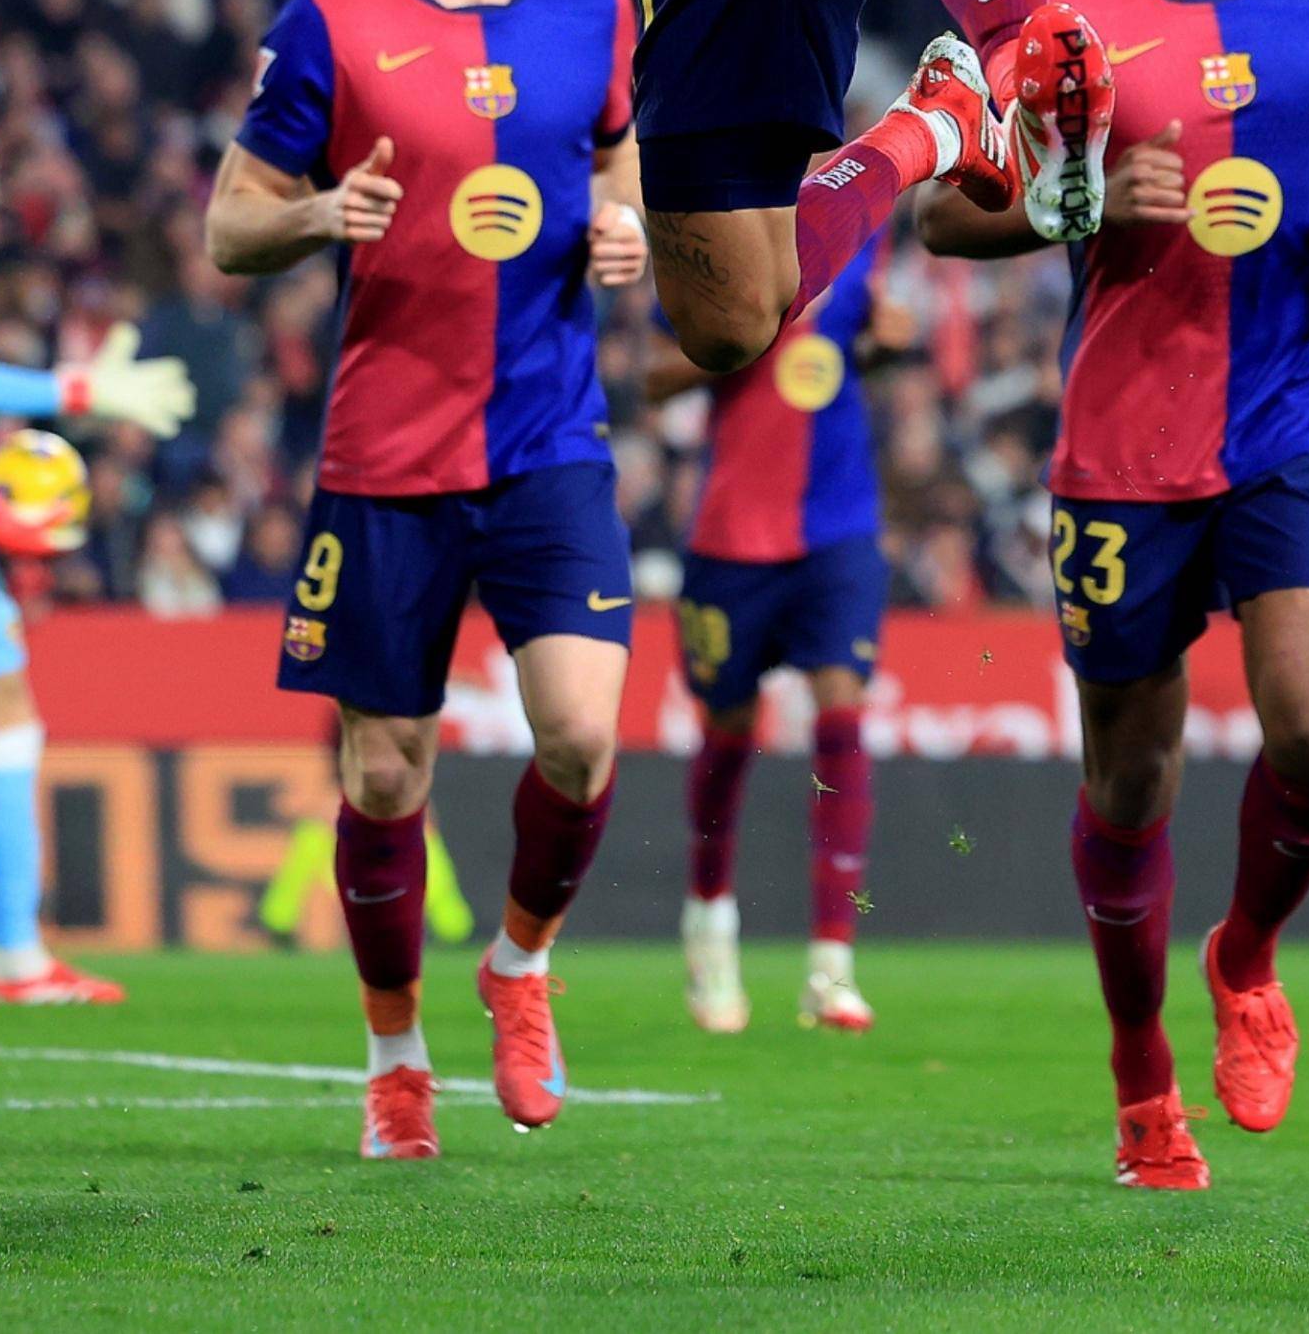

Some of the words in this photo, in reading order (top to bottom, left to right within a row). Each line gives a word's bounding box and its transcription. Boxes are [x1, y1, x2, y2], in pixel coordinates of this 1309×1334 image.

[1053, 28, 1092, 239] PREDATOR
[295, 530, 344, 611] 9
[1053, 508, 1128, 606] 23
